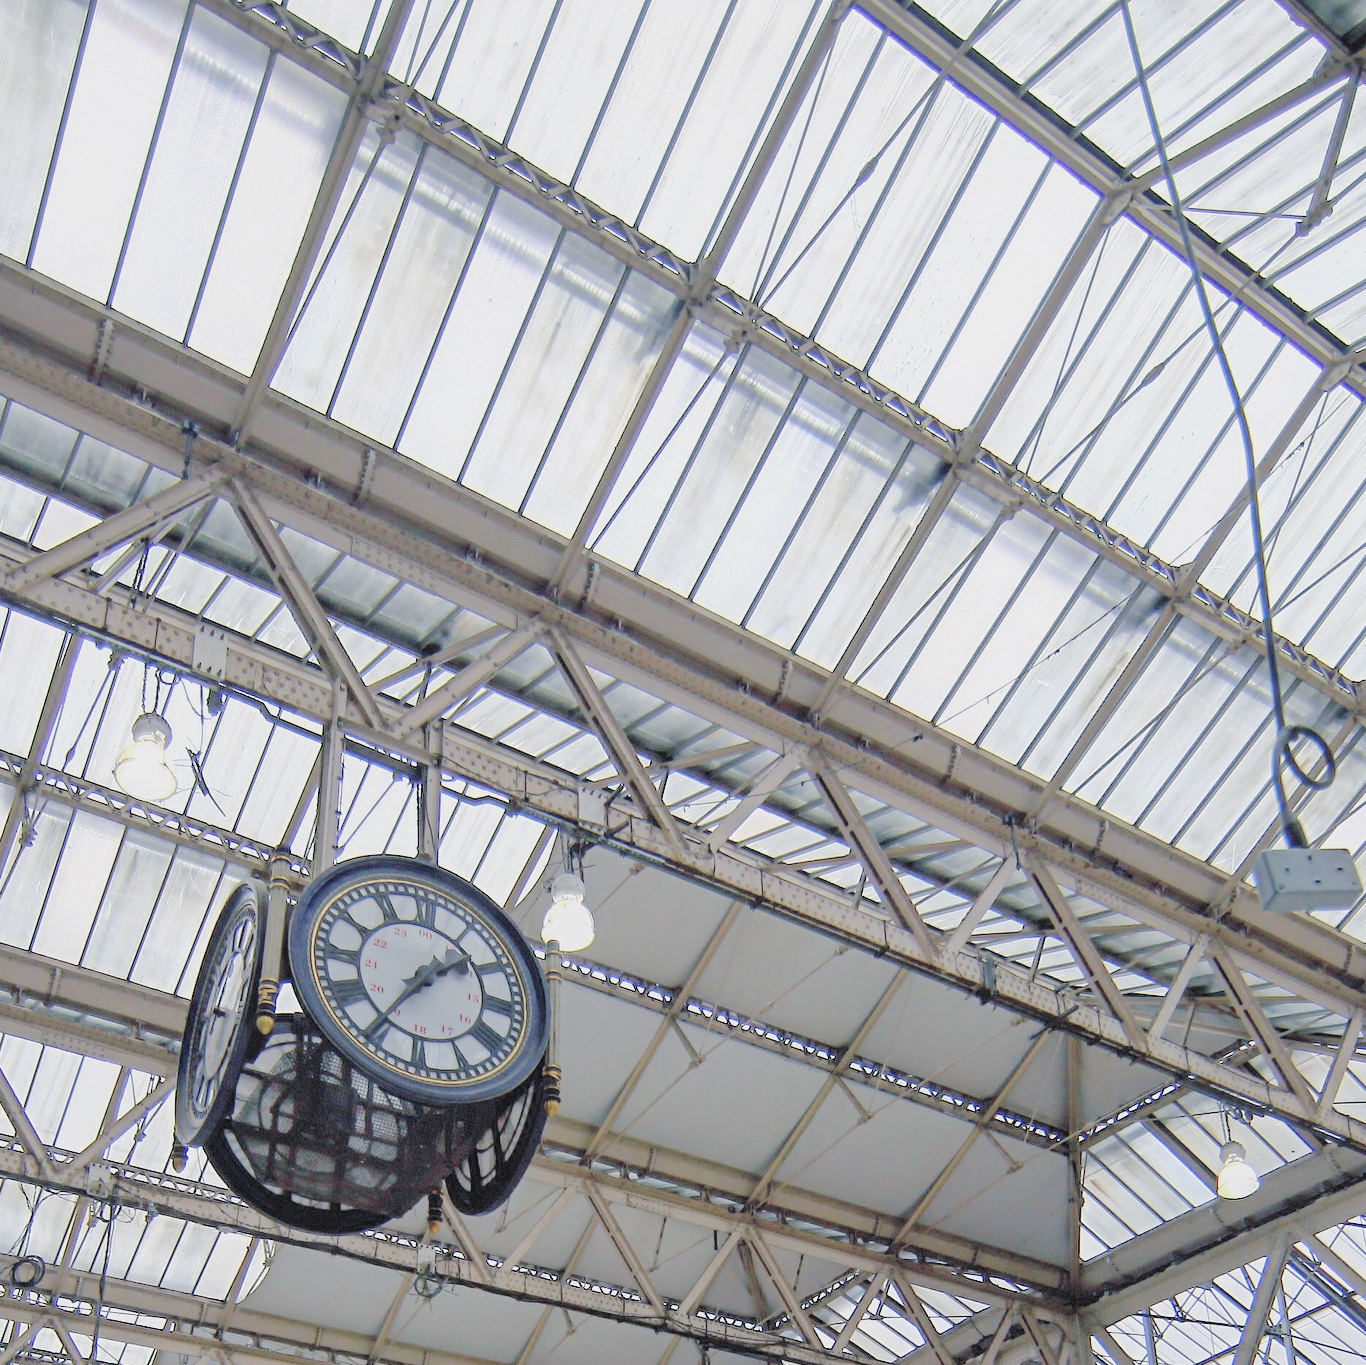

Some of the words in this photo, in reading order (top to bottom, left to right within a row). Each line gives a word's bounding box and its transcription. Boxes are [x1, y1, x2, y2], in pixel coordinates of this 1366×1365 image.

[393, 927, 407, 937] 23
[419, 929, 433, 940] 00
[373, 938, 387, 949] 22
[365, 959, 378, 970] 21
[370, 983, 384, 993] 20
[467, 993, 480, 1003] 15
[459, 1013, 472, 1024] 16
[413, 1024, 427, 1035] 18
[441, 1025, 453, 1035] 17
